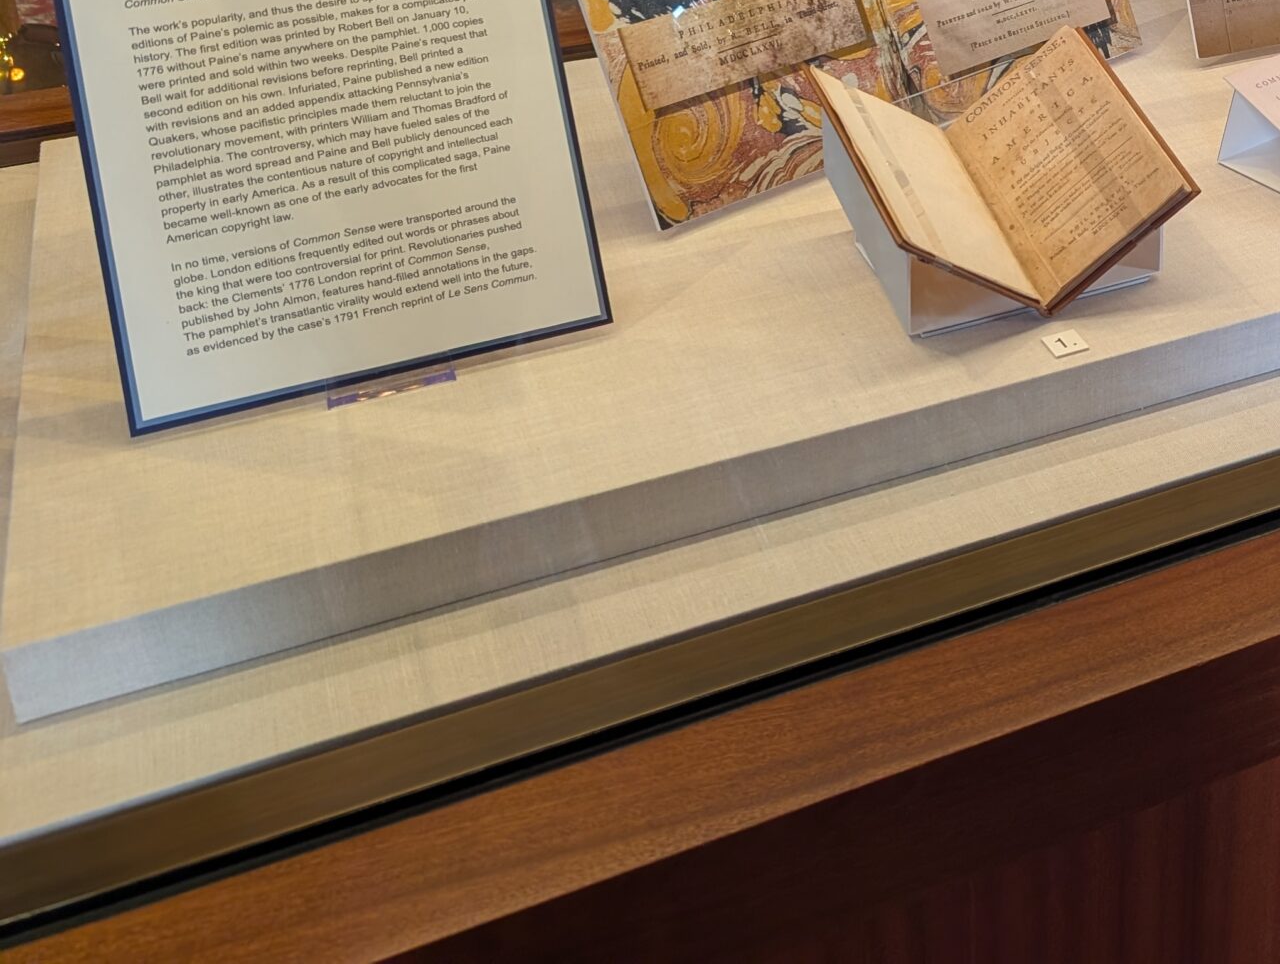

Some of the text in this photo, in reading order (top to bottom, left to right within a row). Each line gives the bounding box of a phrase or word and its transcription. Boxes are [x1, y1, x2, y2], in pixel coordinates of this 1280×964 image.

[992, 0, 1001, 9] by
[635, 53, 670, 71] Printed,
[672, 46, 689, 59] and
[689, 39, 712, 54] Sold,
[715, 34, 727, 46] by
[783, 14, 792, 23] in
[963, 34, 1067, 125] COMMON SENSE;
[979, 56, 1078, 141] INHABITANTS
[181, 307, 235, 330] published
[236, 306, 251, 317] by
[253, 300, 280, 313] John
[321, 282, 365, 298] features
[366, 268, 420, 289] hand-filled
[422, 258, 480, 277] annotations
[480, 254, 492, 264] in
[492, 252, 509, 262] the
[186, 346, 201, 357] as
[202, 331, 259, 353] evidenced
[260, 330, 275, 341] by
[276, 325, 295, 337] the
[333, 310, 359, 324] 1791
[362, 301, 399, 317] French
[400, 293, 434, 309] reprint
[435, 290, 446, 301] of
[448, 289, 461, 299] Le
[463, 283, 489, 295] Sens
[1054, 337, 1078, 348] 1.
